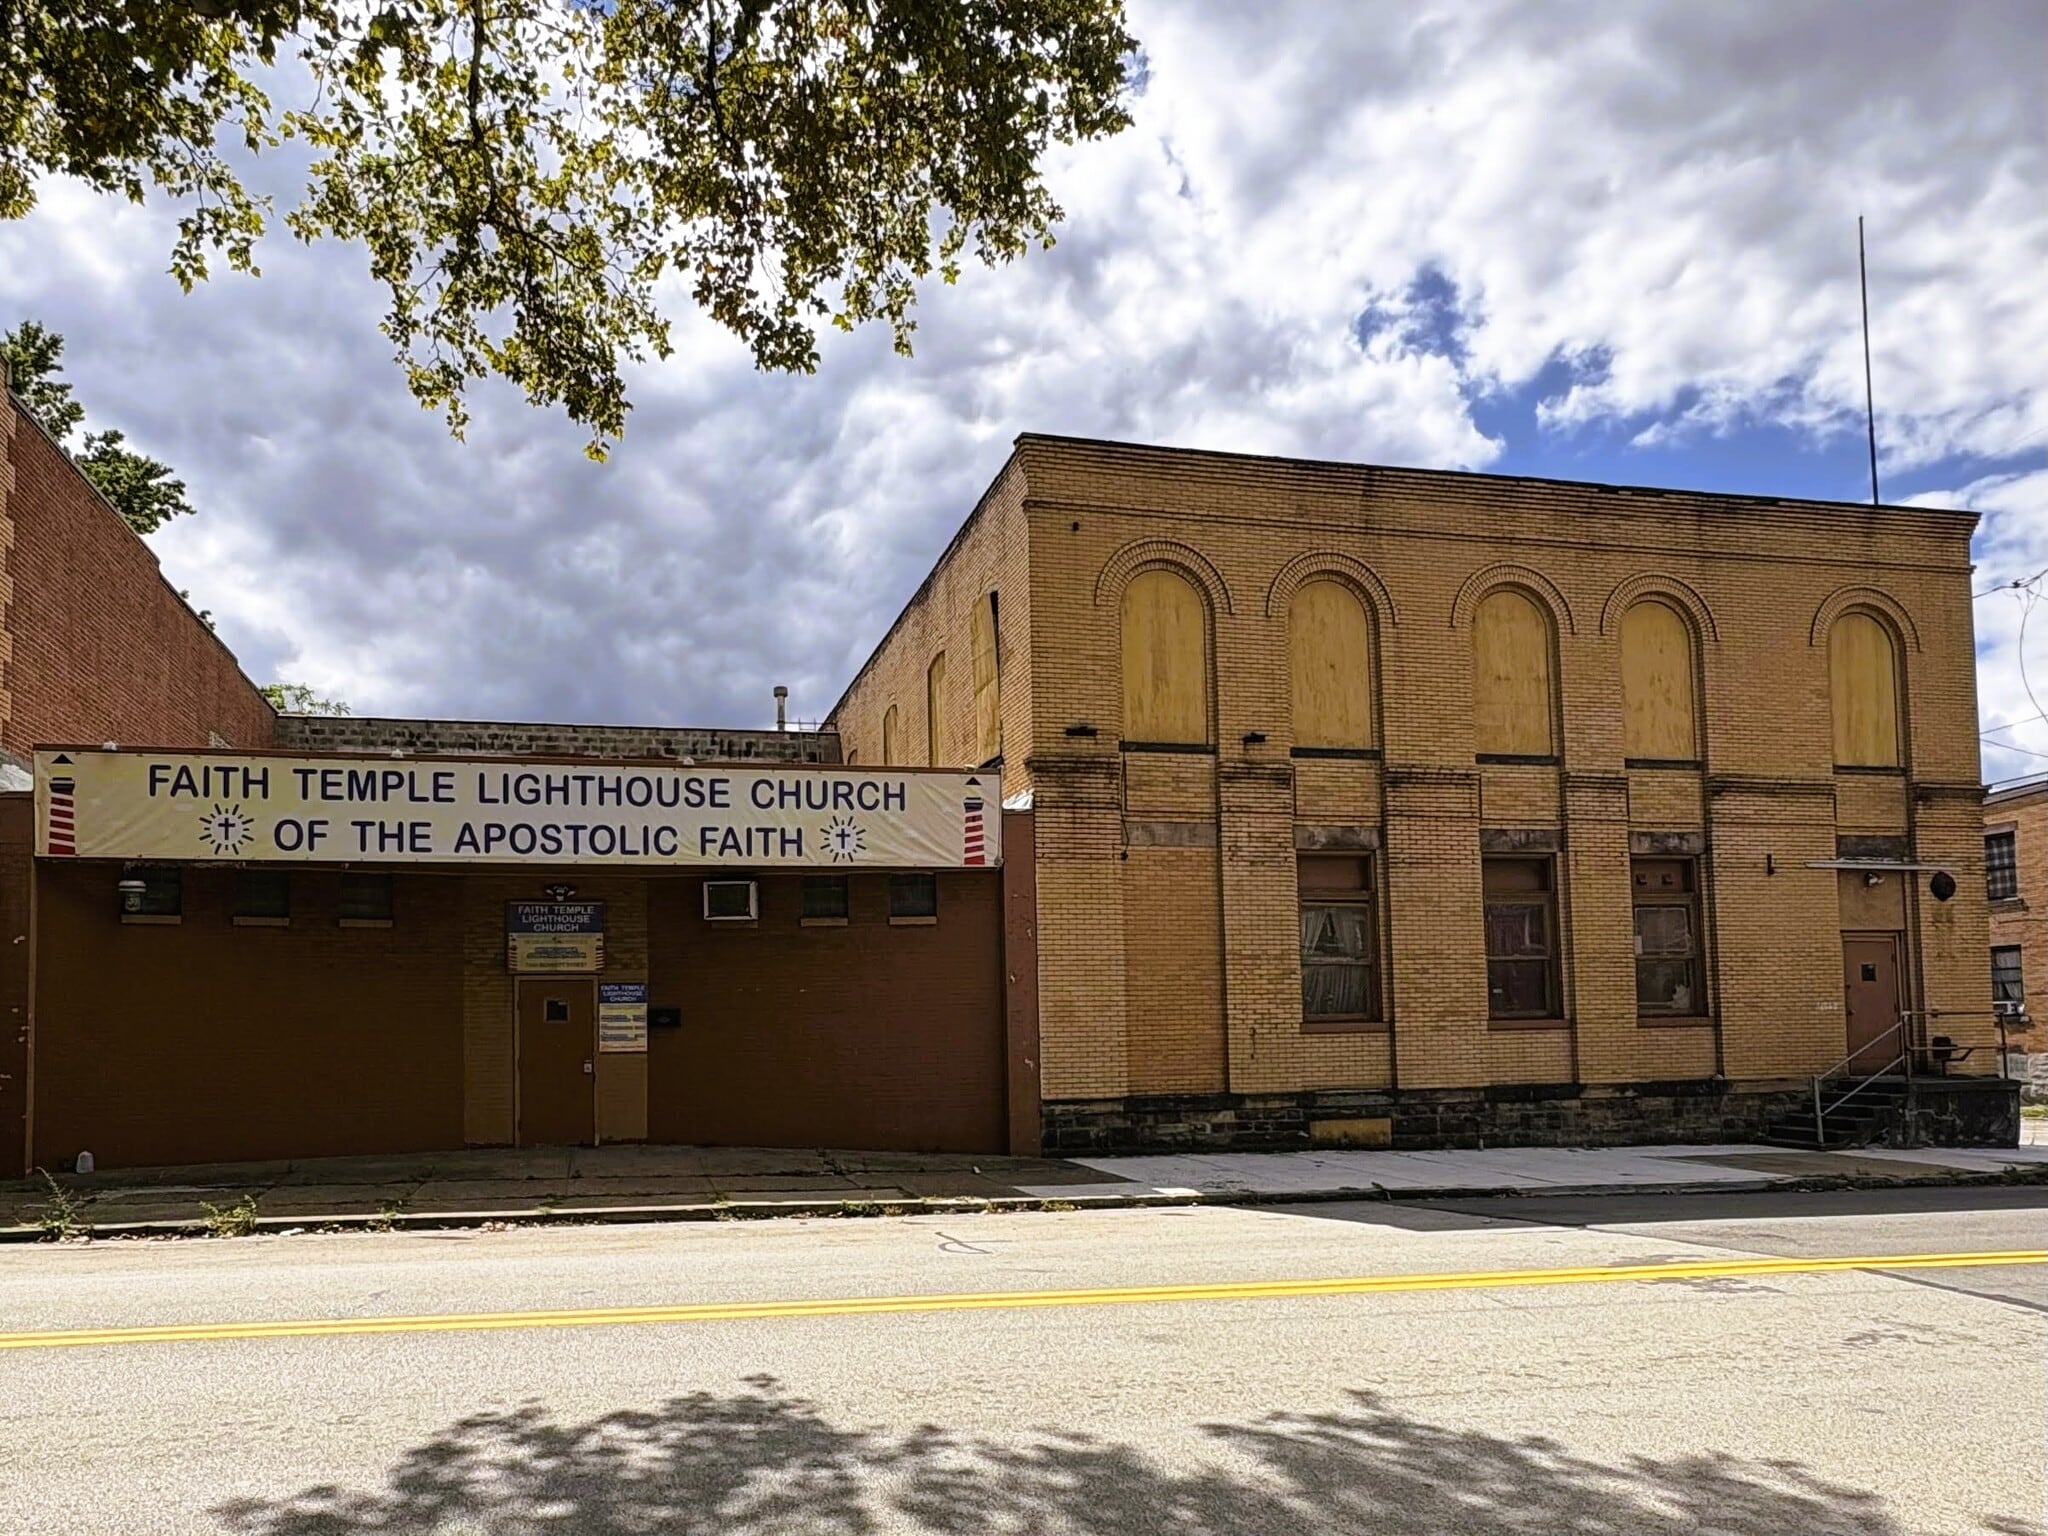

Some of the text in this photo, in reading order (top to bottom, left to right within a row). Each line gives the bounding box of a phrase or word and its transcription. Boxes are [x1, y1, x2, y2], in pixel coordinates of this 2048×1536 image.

[149, 764, 906, 812] FAITH TEMPLE LIGHTHOUSE CHURCH
[273, 818, 803, 858] OF THE APOSTOLIC FAITH
[518, 905, 595, 914] FAITH TEMPLE
[521, 914, 591, 923] LIGHTHOUSE
[533, 923, 579, 932] CHURCH
